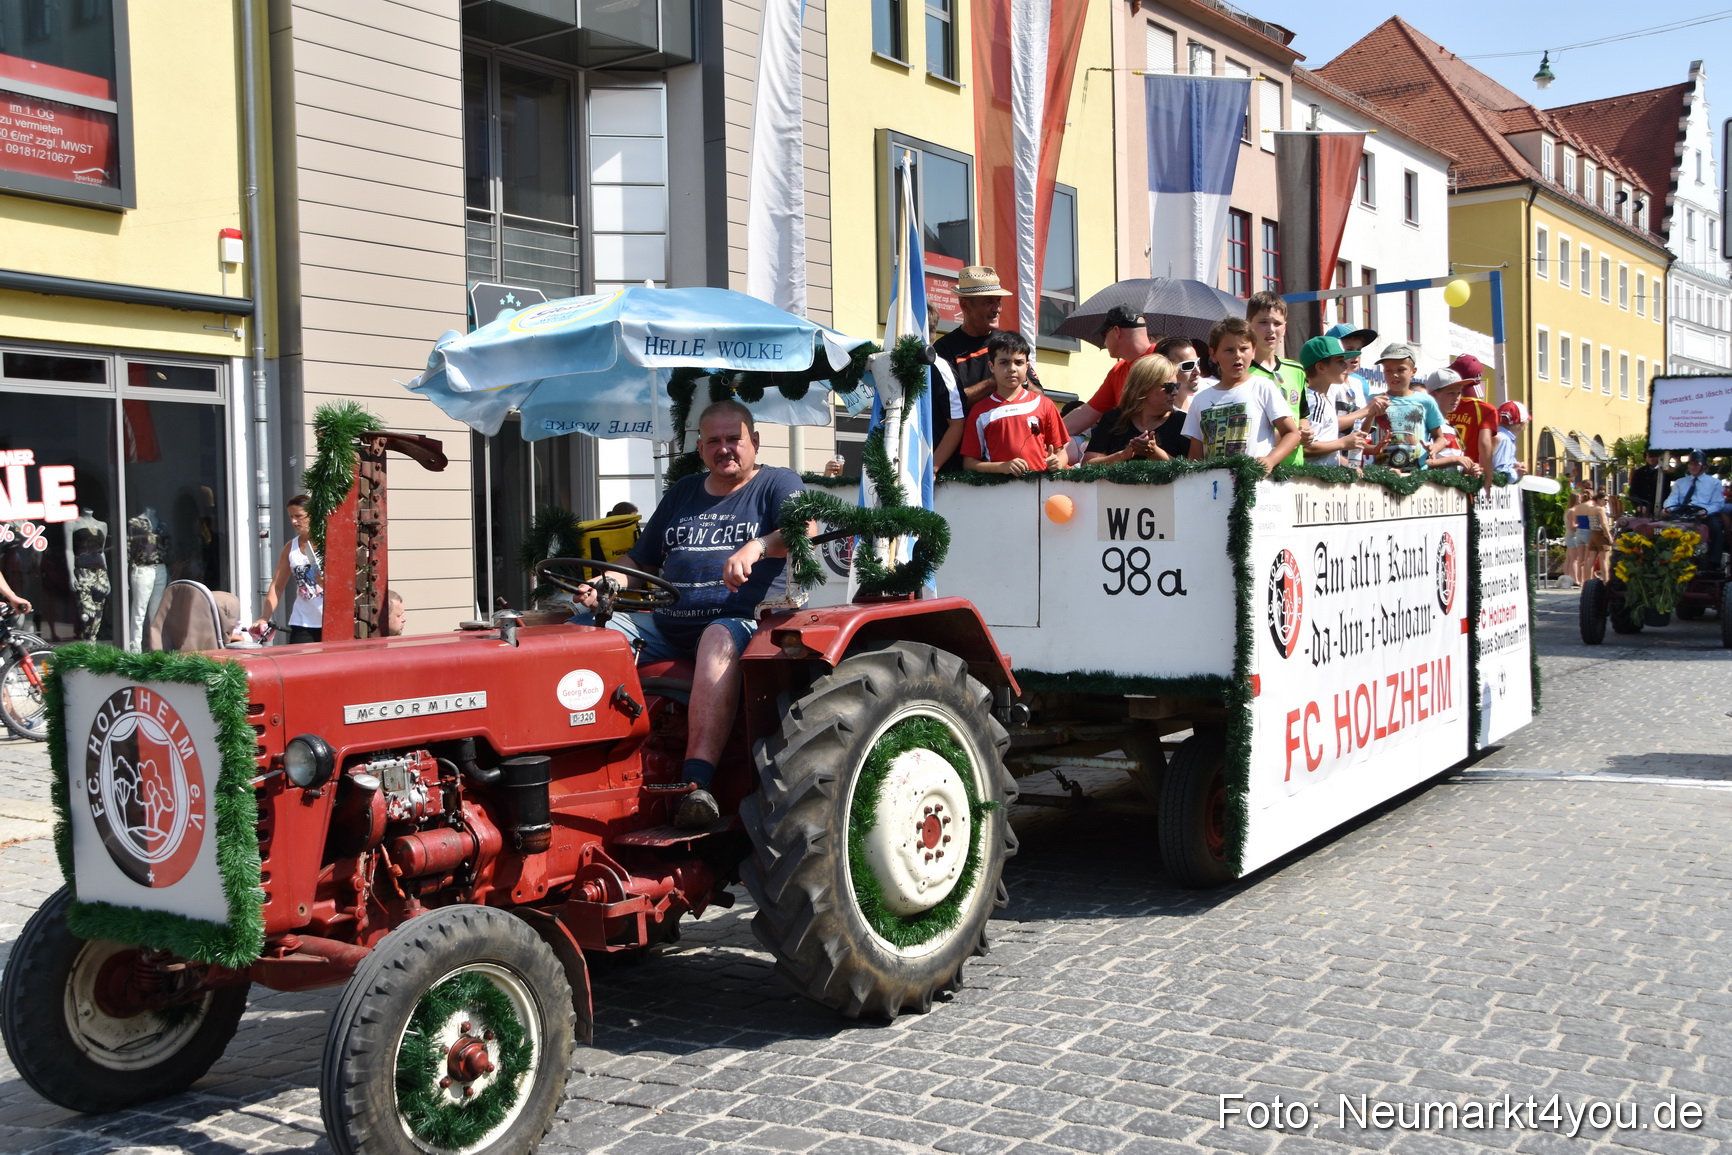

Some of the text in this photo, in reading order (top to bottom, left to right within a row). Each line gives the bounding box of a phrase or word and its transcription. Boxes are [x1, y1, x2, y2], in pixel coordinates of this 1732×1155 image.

[9, 102, 55, 120] im 1. OG
[0, 115, 64, 135] zu vermieten
[5, 143, 76, 165] 09181/210677
[36, 137, 58, 149] zzgl.
[61, 140, 94, 155] MWST
[643, 336, 784, 360] HELLE WOLKE
[1695, 392, 1704, 400] da
[1201, 403, 1246, 421] STEREO
[1446, 412, 1472, 425] SPAÑA
[1295, 492, 1318, 525] Wir
[1325, 492, 1349, 523] sind
[1356, 490, 1375, 521] die
[1410, 486, 1464, 516] Fussballer
[1494, 485, 1511, 510] Markt
[710, 521, 760, 545] CREW
[1107, 507, 1165, 541] WG.
[1479, 521, 1494, 539] eues
[1313, 541, 1345, 598] Am
[1479, 547, 1494, 569] echn.
[1268, 550, 1302, 592] HOLZHEIM
[1488, 601, 1517, 628] Holzheim
[1494, 627, 1519, 655] Sportheim
[562, 686, 599, 698] Georg Koch
[88, 689, 195, 761] HOLZHEIM
[1284, 655, 1452, 783] FC HOLZHEIM
